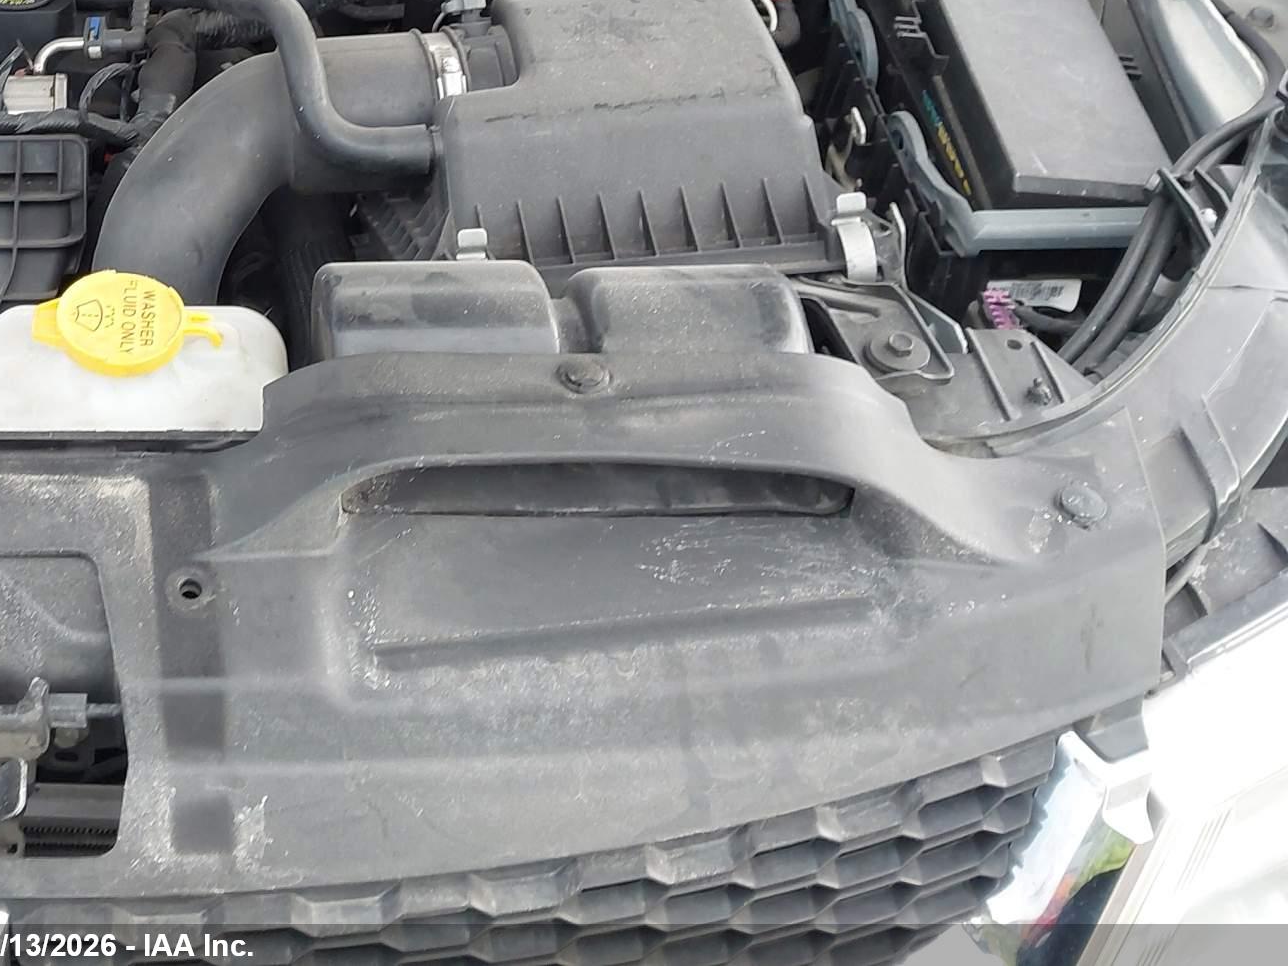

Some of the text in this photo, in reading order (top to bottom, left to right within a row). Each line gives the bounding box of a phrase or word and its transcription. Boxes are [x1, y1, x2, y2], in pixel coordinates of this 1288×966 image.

[120, 280, 138, 354] FLUID ONLY
[140, 290, 156, 346] WASHER
